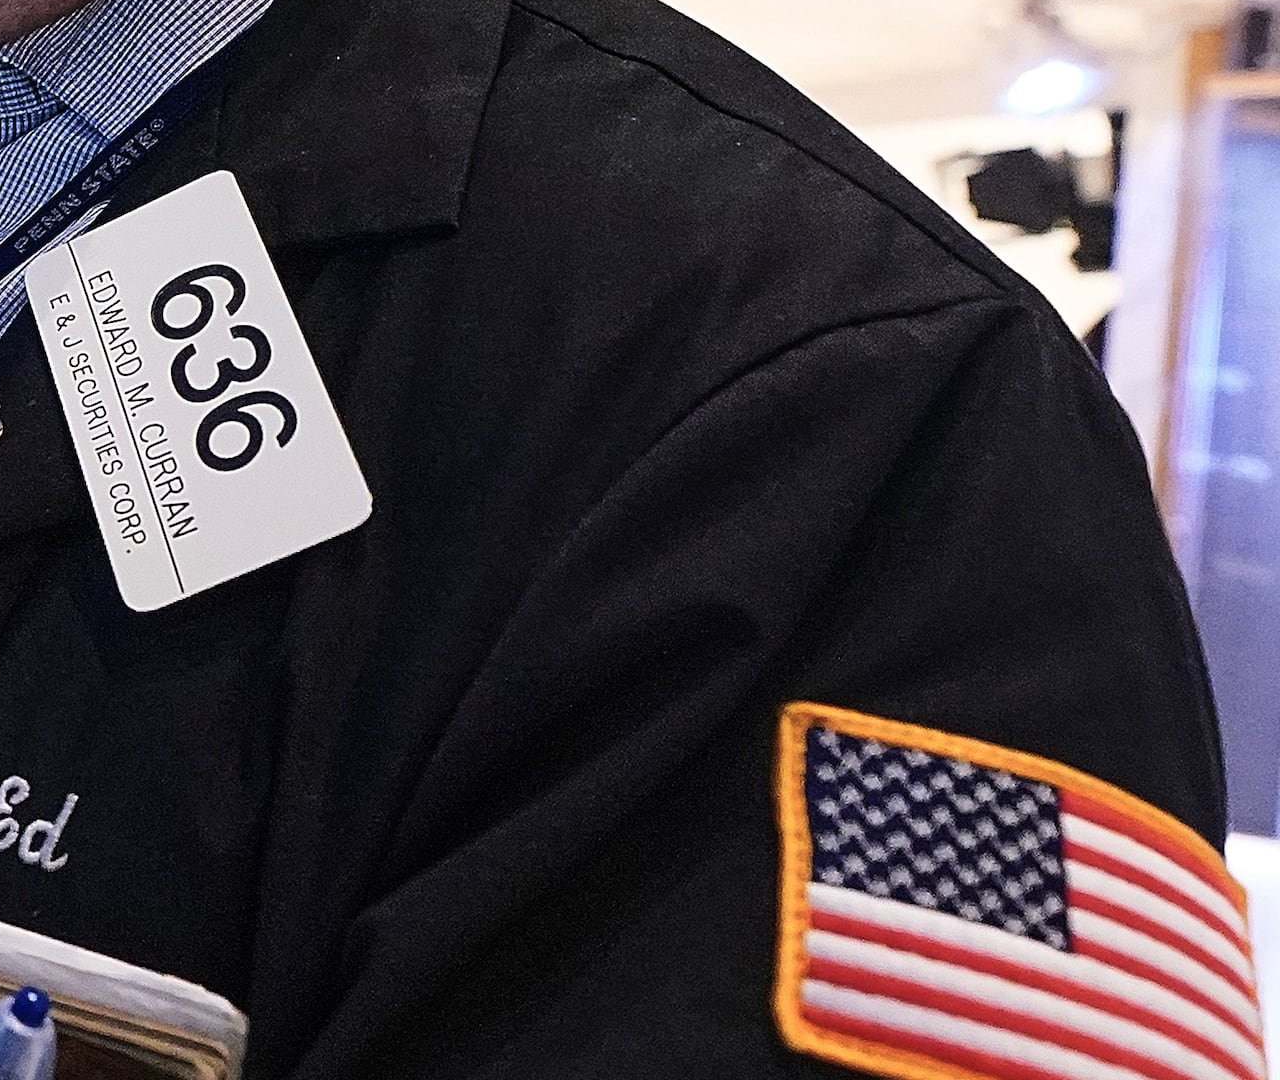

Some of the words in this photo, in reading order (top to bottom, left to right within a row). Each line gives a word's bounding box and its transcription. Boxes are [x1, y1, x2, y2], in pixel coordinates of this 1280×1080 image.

[14, 193, 82, 254] PENN
[49, 294, 71, 310] E
[56, 314, 77, 332] &
[62, 336, 84, 349] J
[151, 264, 297, 472] 636
[69, 352, 124, 476] SECURITIES
[88, 270, 143, 377] EDWARD
[124, 382, 155, 418] M.
[140, 423, 199, 539] CURRAN
[109, 483, 147, 555] CORP.
